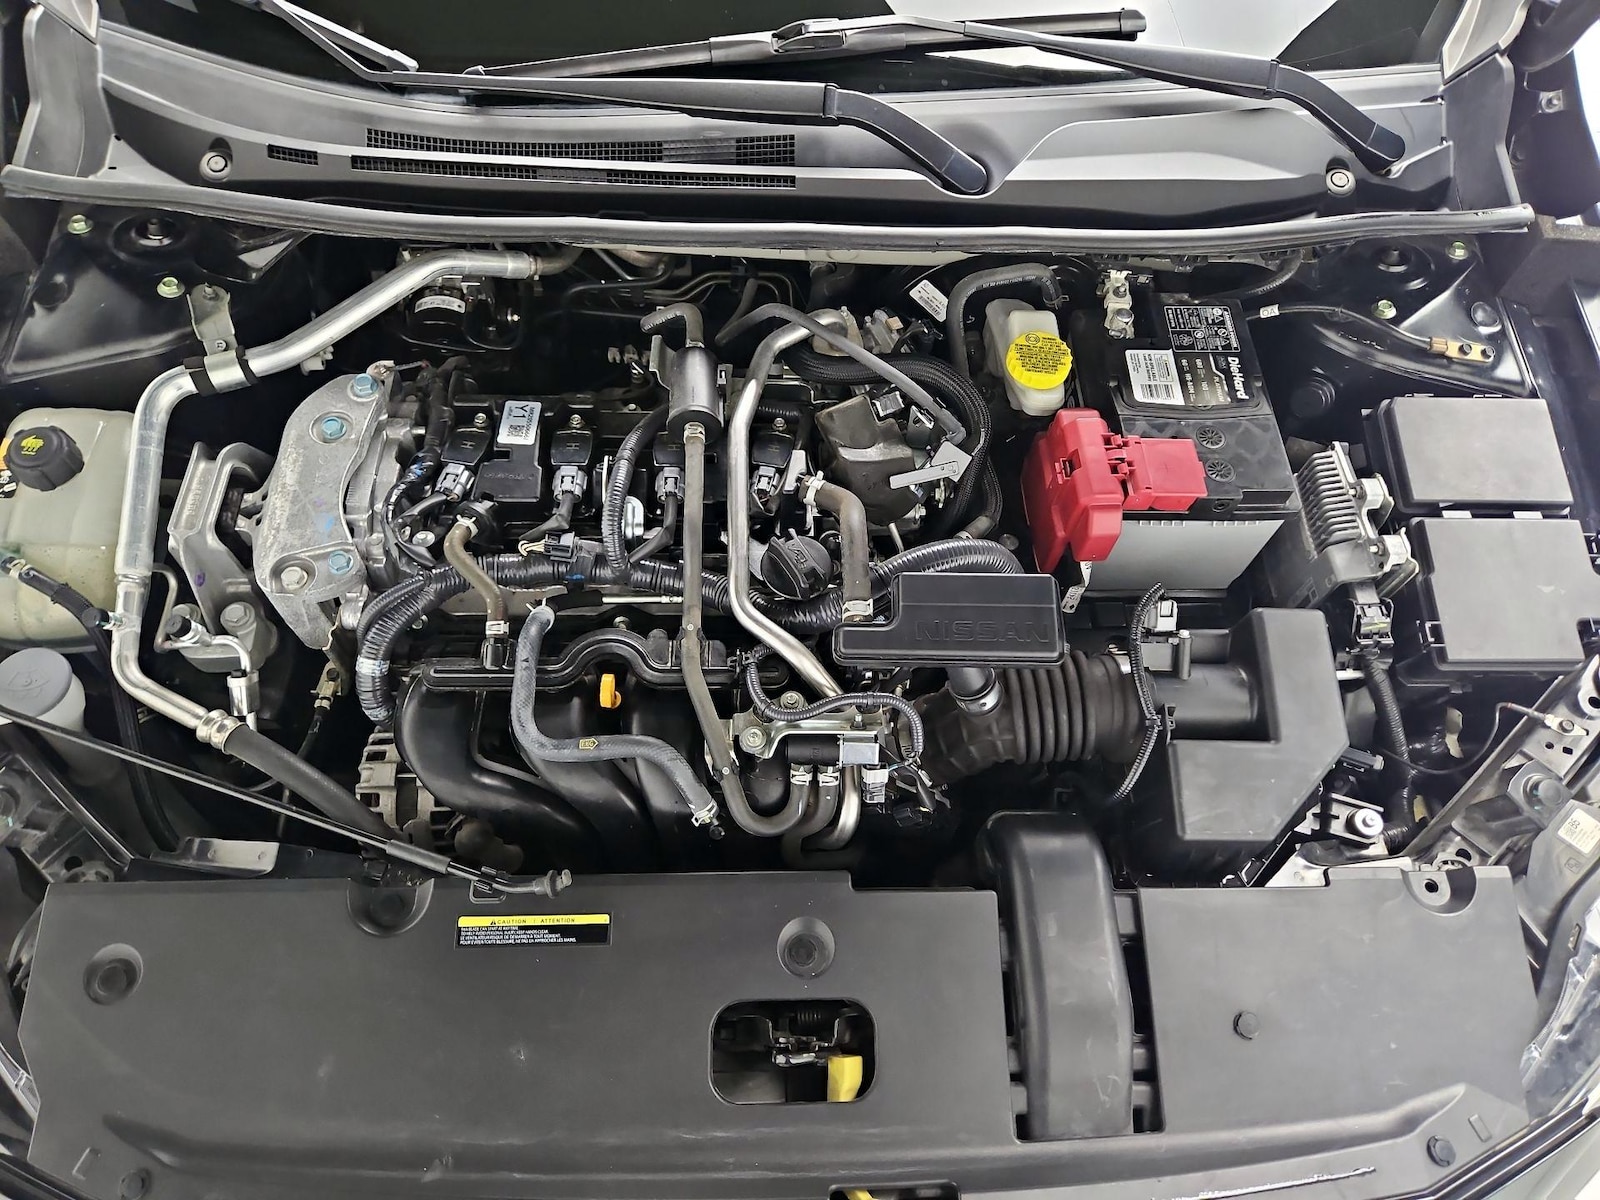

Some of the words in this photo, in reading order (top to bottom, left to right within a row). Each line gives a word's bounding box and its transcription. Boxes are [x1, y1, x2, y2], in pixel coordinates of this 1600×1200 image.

[1213, 376, 1224, 402] PLATINUM
[1228, 356, 1250, 400] DieHard
[512, 404, 529, 418] Y1
[915, 620, 1050, 642] NISSAN
